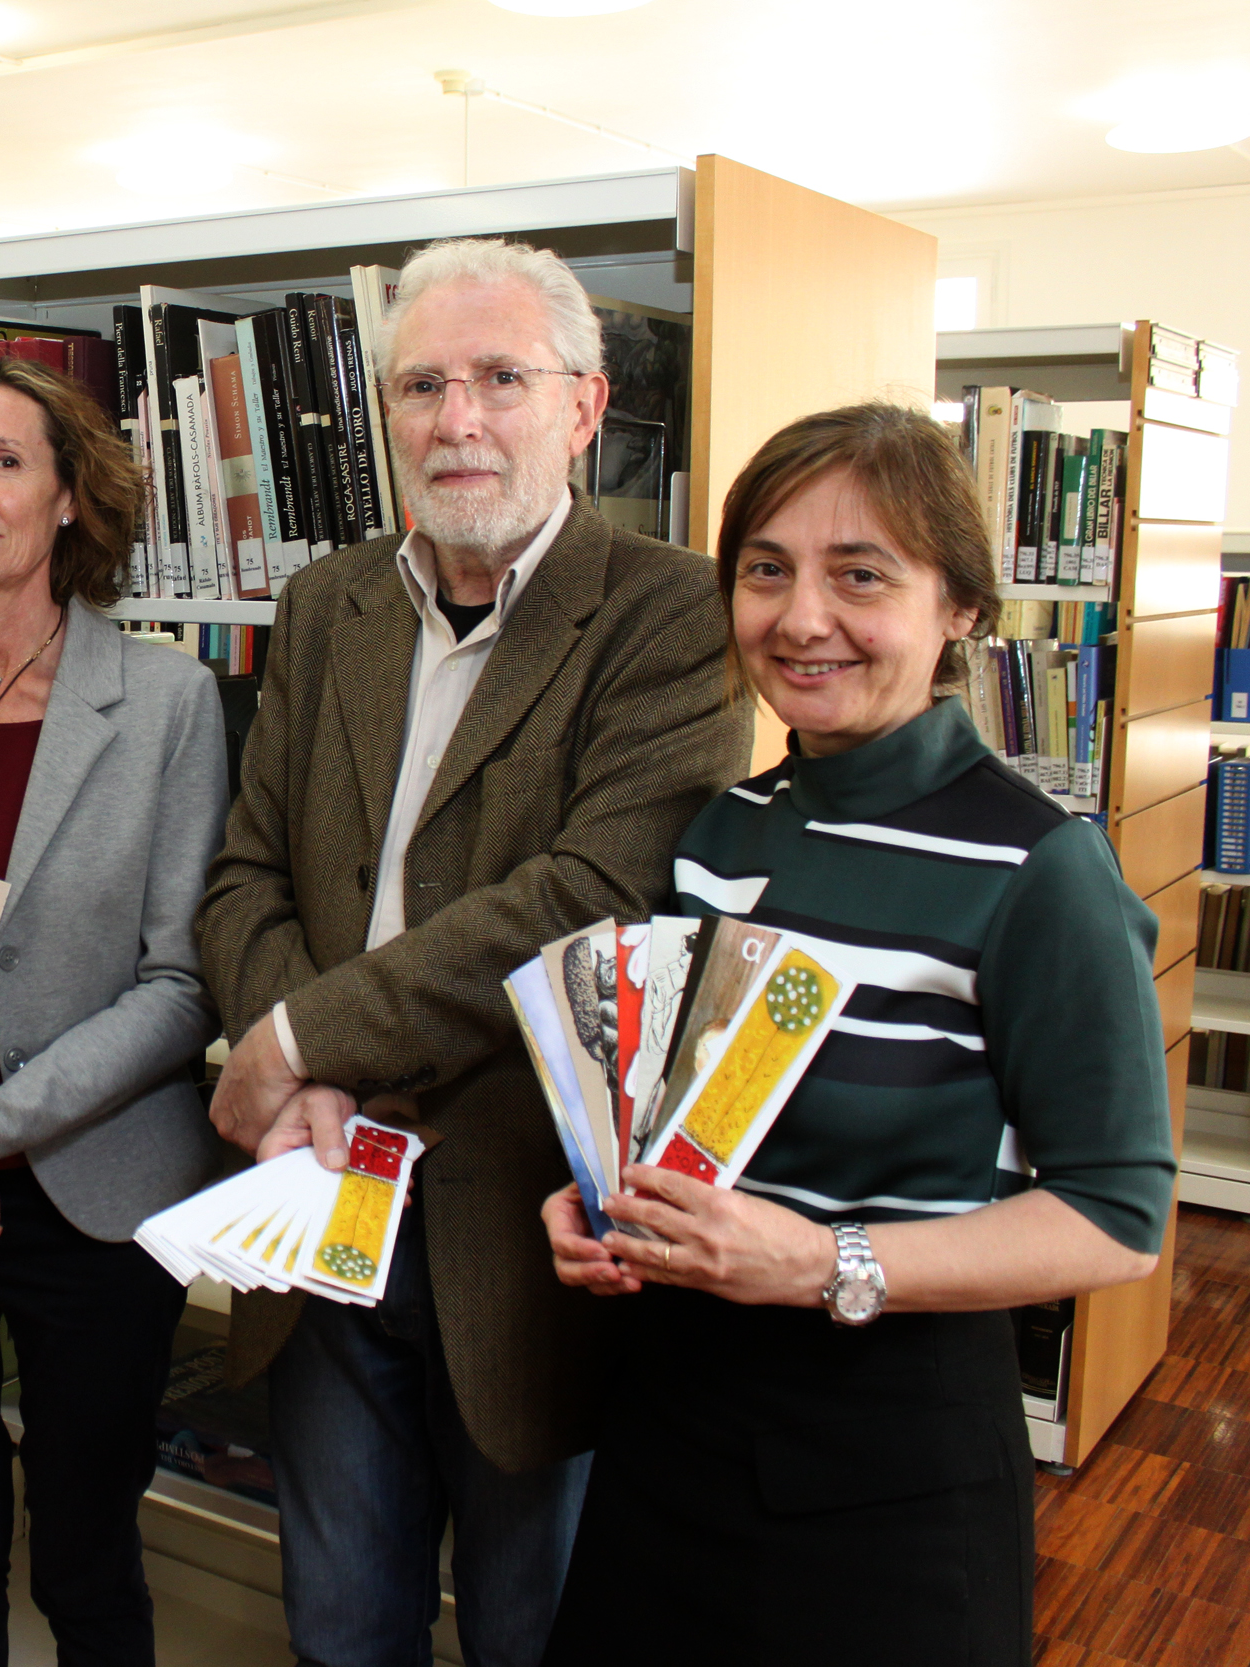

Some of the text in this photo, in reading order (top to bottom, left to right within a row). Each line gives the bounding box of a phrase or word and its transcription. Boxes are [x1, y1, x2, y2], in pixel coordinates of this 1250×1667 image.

[154, 319, 164, 346] Rafael
[289, 308, 304, 363] Guido Reni
[308, 310, 318, 341] Renoir
[326, 335, 335, 366] realisme
[115, 322, 128, 413] Piero della Francesca
[330, 367, 338, 378] del
[345, 340, 358, 391] JULIO TRENAS
[230, 371, 242, 440] SIMON SCHAMA
[272, 388, 280, 413] Taller
[331, 379, 343, 417] vindicació
[353, 407, 368, 447] TORO
[258, 434, 267, 461] Maestro
[279, 430, 288, 459] Maestro
[1010, 431, 1018, 455] FUTBOL
[1103, 449, 1108, 458] DE
[186, 393, 206, 526] ÀLBUM RÀFOLS-CASAMADA
[358, 450, 370, 468] DE
[1010, 456, 1016, 464] DE
[338, 443, 356, 521] ROCA-SASTRE
[1008, 466, 1016, 485] CLUBS
[1089, 465, 1098, 486] BILLAR
[1107, 478, 1112, 487] LA
[279, 475, 299, 538] Rembrandt
[1007, 487, 1015, 502] DELS
[260, 479, 278, 541] Rembrandt
[1005, 503, 1013, 533] HISTÒRIA
[1086, 500, 1095, 519] LIBRO
[1097, 489, 1111, 538] BILLAR
[1085, 521, 1094, 541] GRAN
[157, 1440, 204, 1464] POSTIMP
